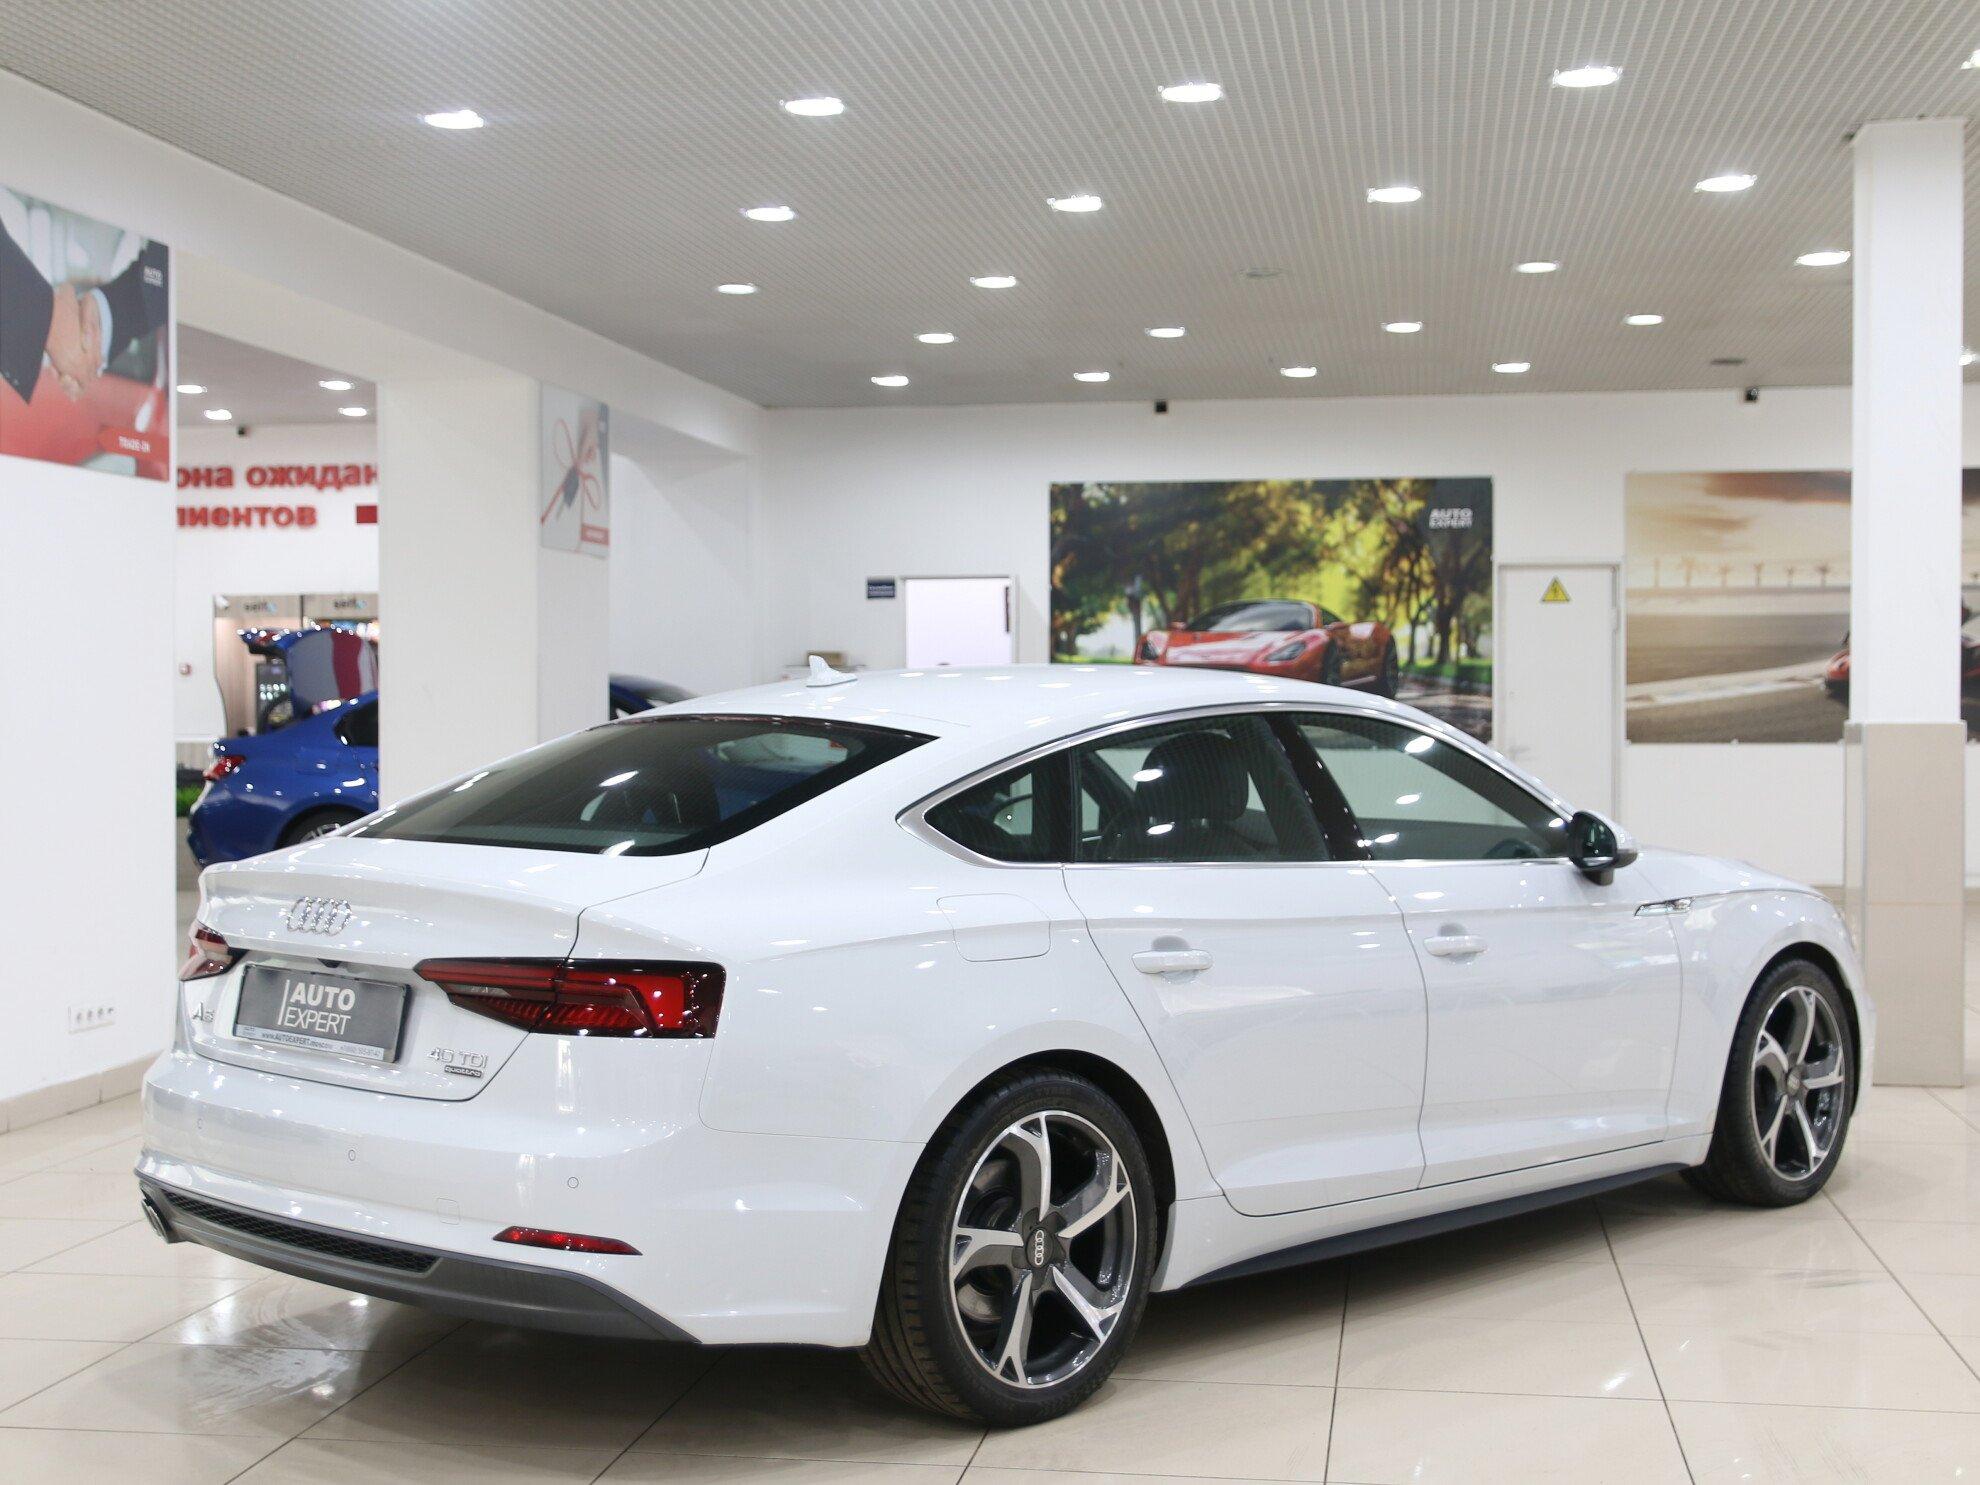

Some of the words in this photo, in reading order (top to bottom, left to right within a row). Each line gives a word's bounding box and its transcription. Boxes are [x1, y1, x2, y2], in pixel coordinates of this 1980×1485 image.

[1430, 508, 1473, 519] AUTO
[290, 982, 356, 1012] AUTO
[284, 1007, 351, 1036] EXPERT
[459, 1051, 489, 1069] TDI
